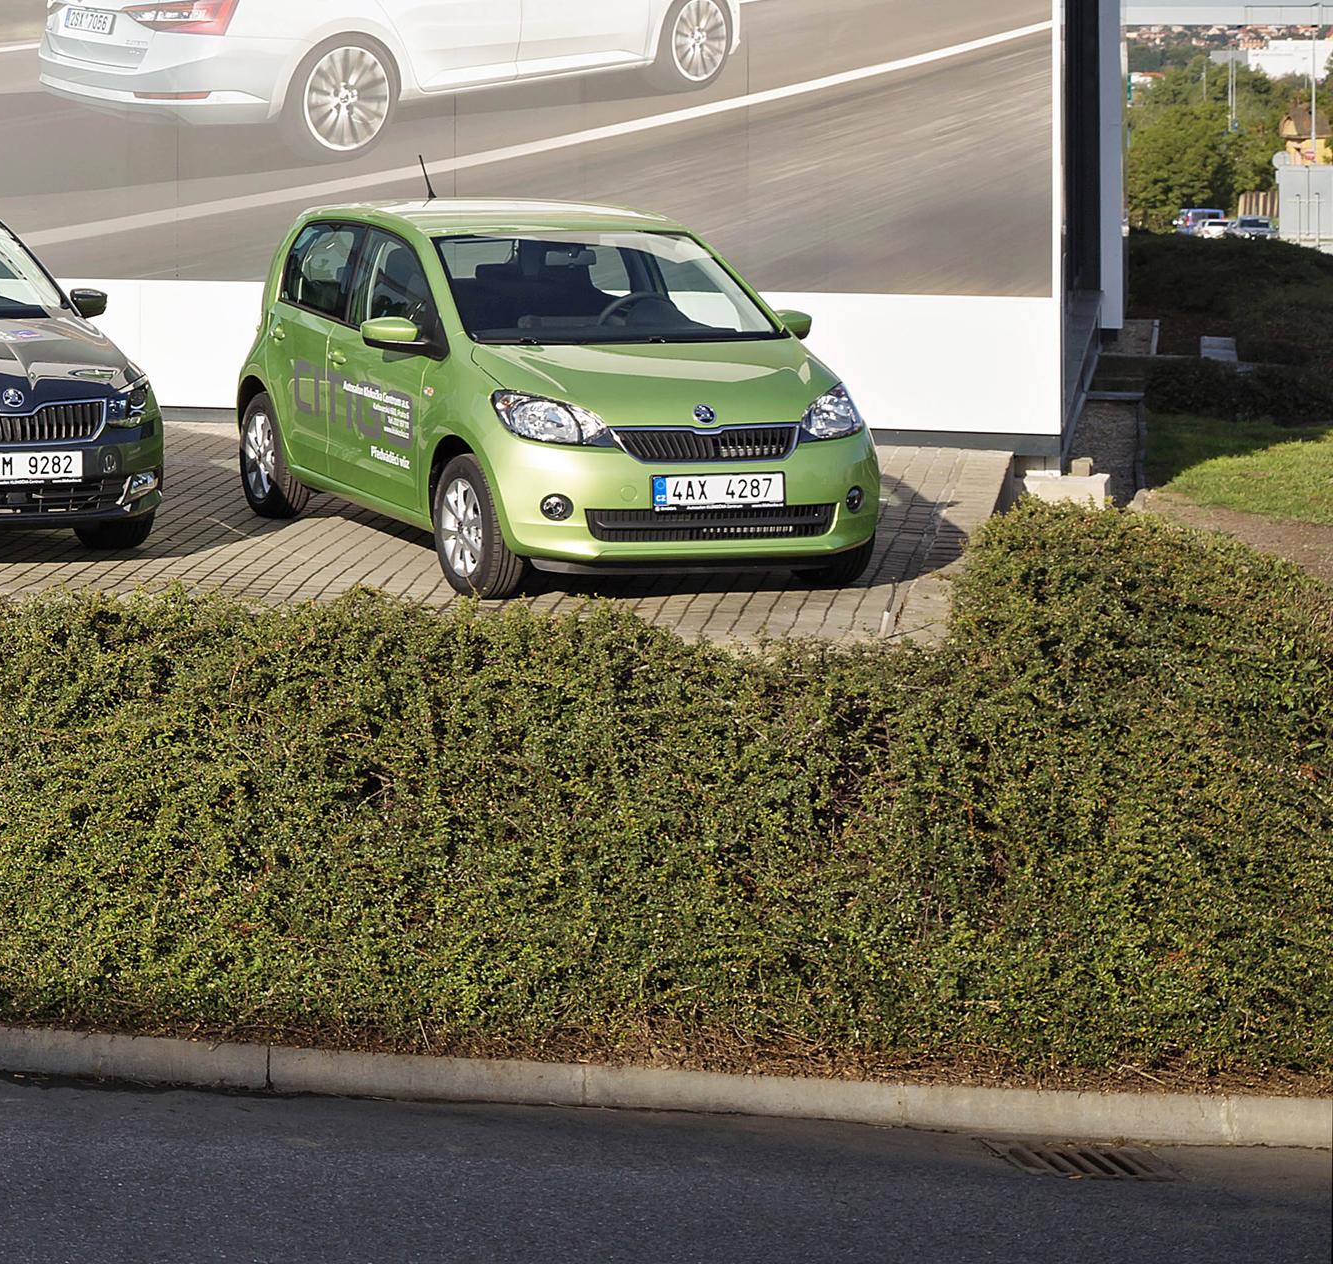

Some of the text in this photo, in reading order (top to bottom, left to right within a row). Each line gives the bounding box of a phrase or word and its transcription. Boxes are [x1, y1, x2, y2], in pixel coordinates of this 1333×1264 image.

[69, 11, 109, 31] 2SX 7056
[28, 455, 73, 475] 9282
[655, 478, 772, 502] CZ 4AX 4287
